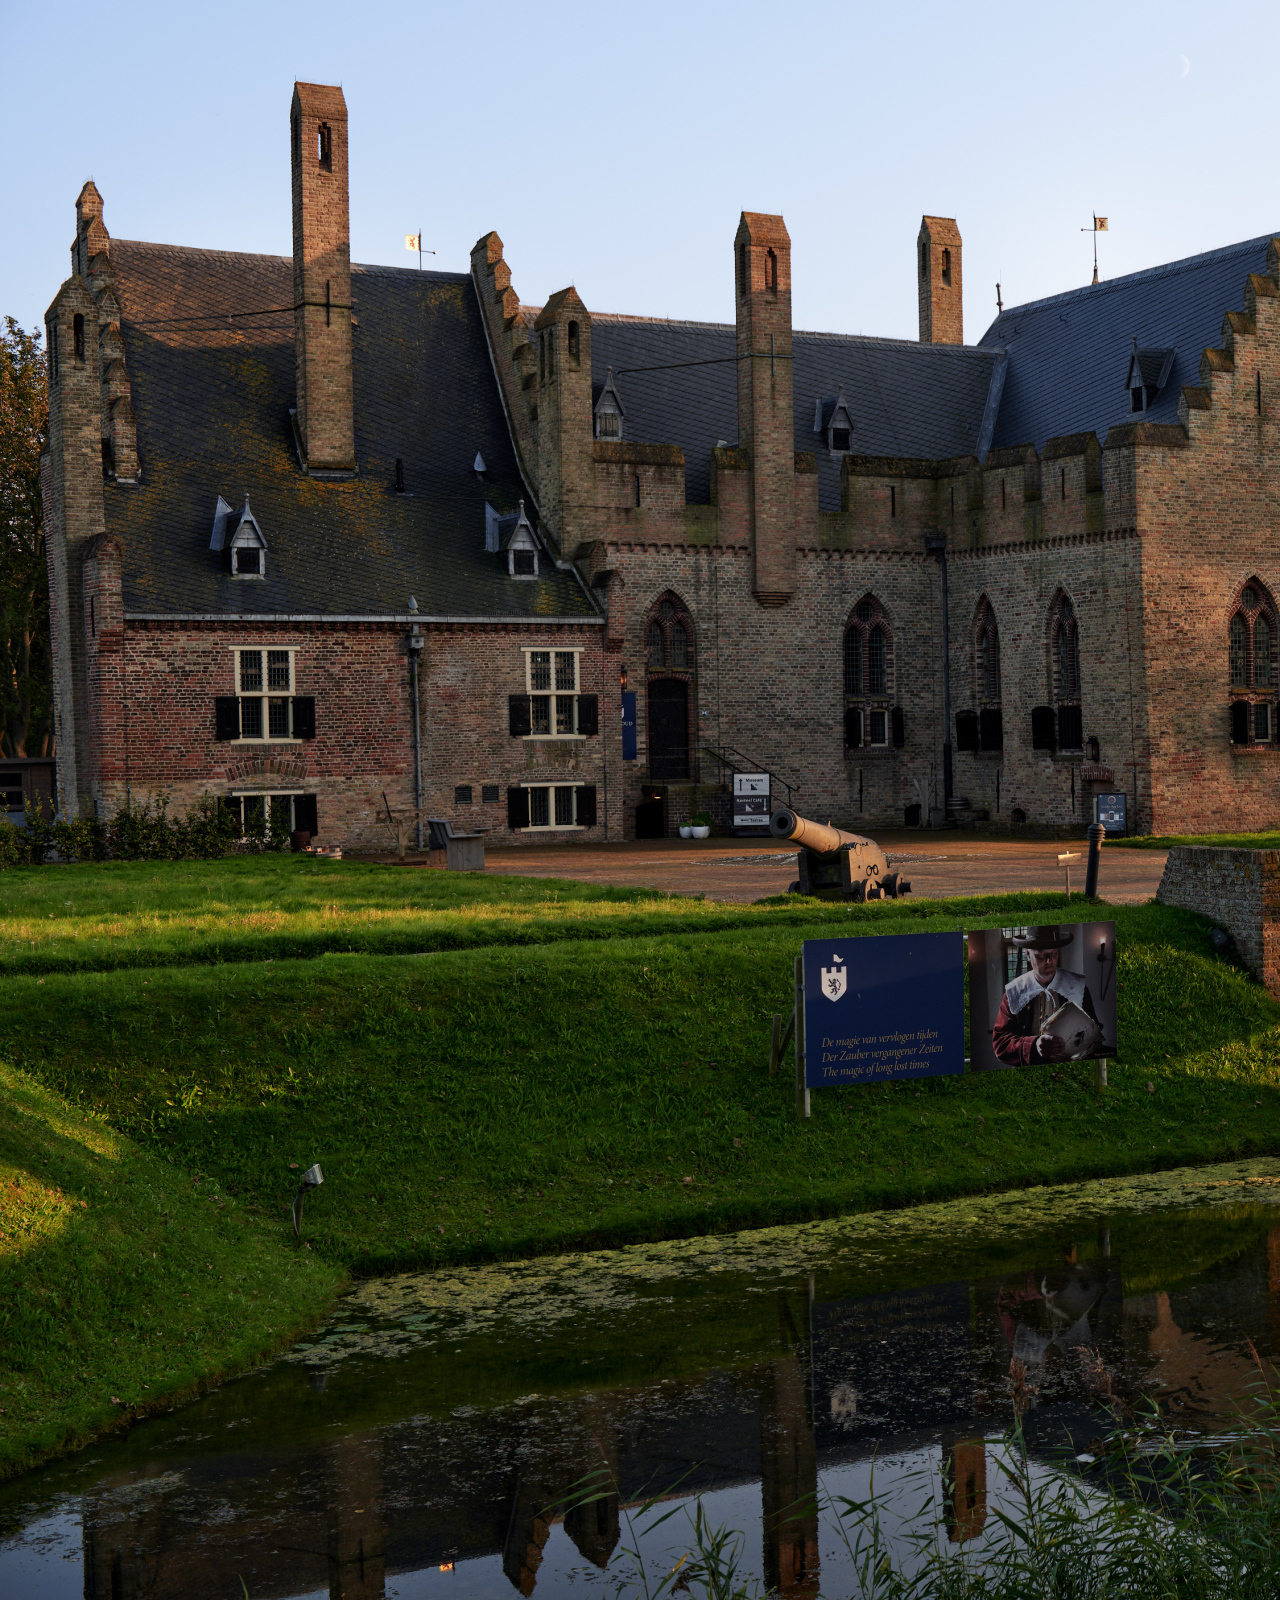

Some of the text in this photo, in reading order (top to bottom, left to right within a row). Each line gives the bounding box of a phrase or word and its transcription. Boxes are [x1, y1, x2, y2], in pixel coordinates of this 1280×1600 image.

[822, 1029, 938, 1049] De magie van vervlogen tijden
[822, 1044, 943, 1062] Der Zauber vergangener Zeiten
[822, 1060, 930, 1078] The magic of long lost times
